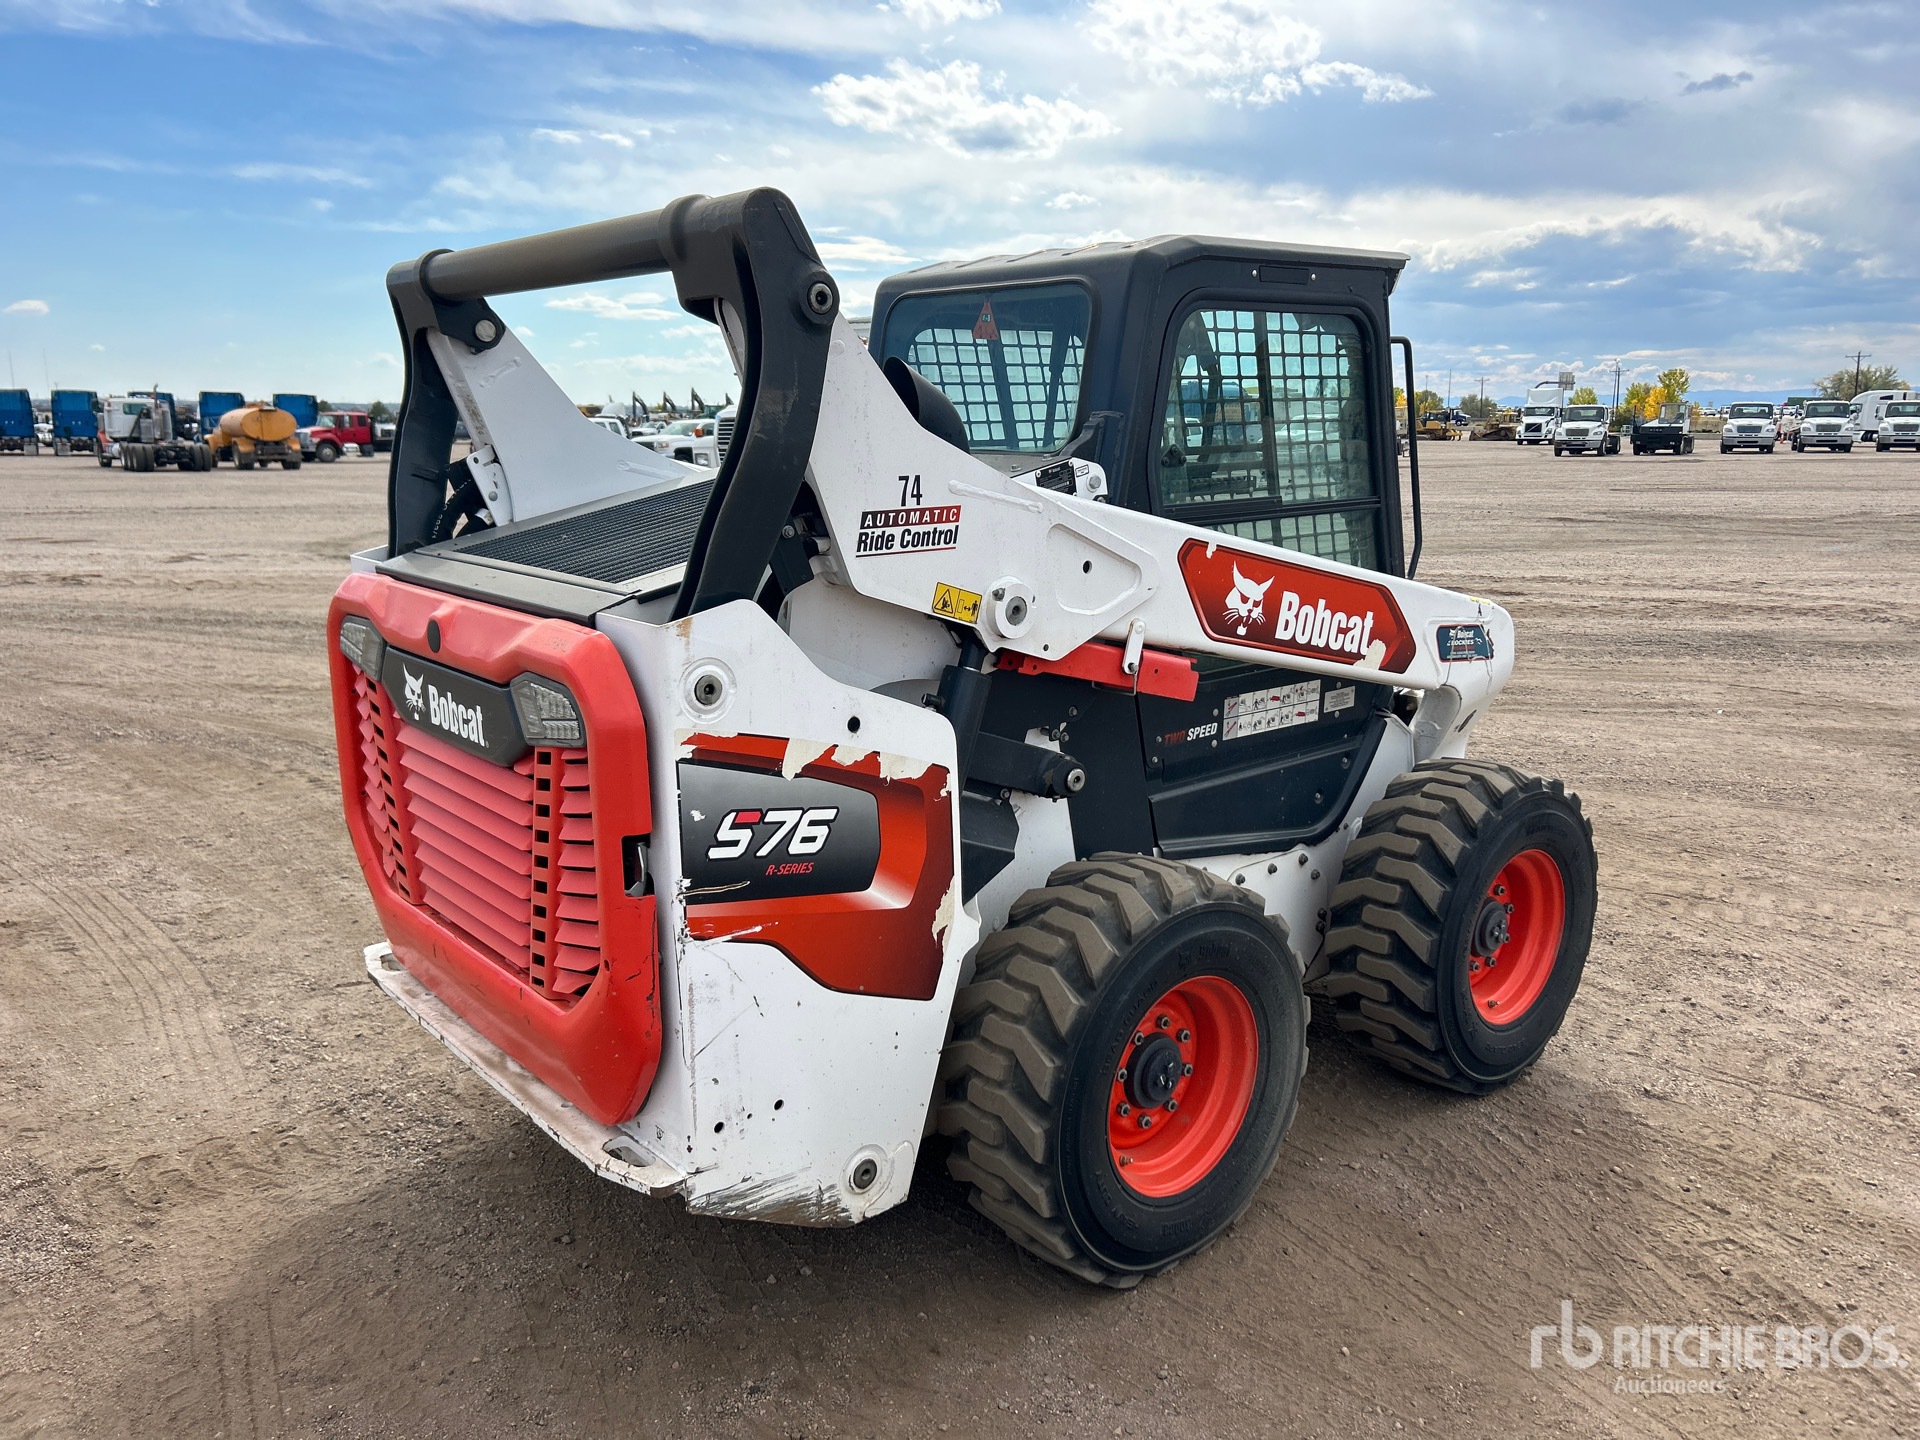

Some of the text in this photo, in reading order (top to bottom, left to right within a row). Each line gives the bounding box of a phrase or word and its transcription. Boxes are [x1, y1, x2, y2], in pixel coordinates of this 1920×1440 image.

[899, 474, 922, 506] 74
[863, 508, 958, 527] AUTOMATIC
[856, 525, 957, 553] Ride Control
[1274, 590, 1374, 656] Bobcat
[427, 684, 486, 747] Bobcat
[1164, 722, 1218, 746] TWO SPEED
[708, 808, 839, 860] S76
[765, 861, 815, 876] R-SERIES
